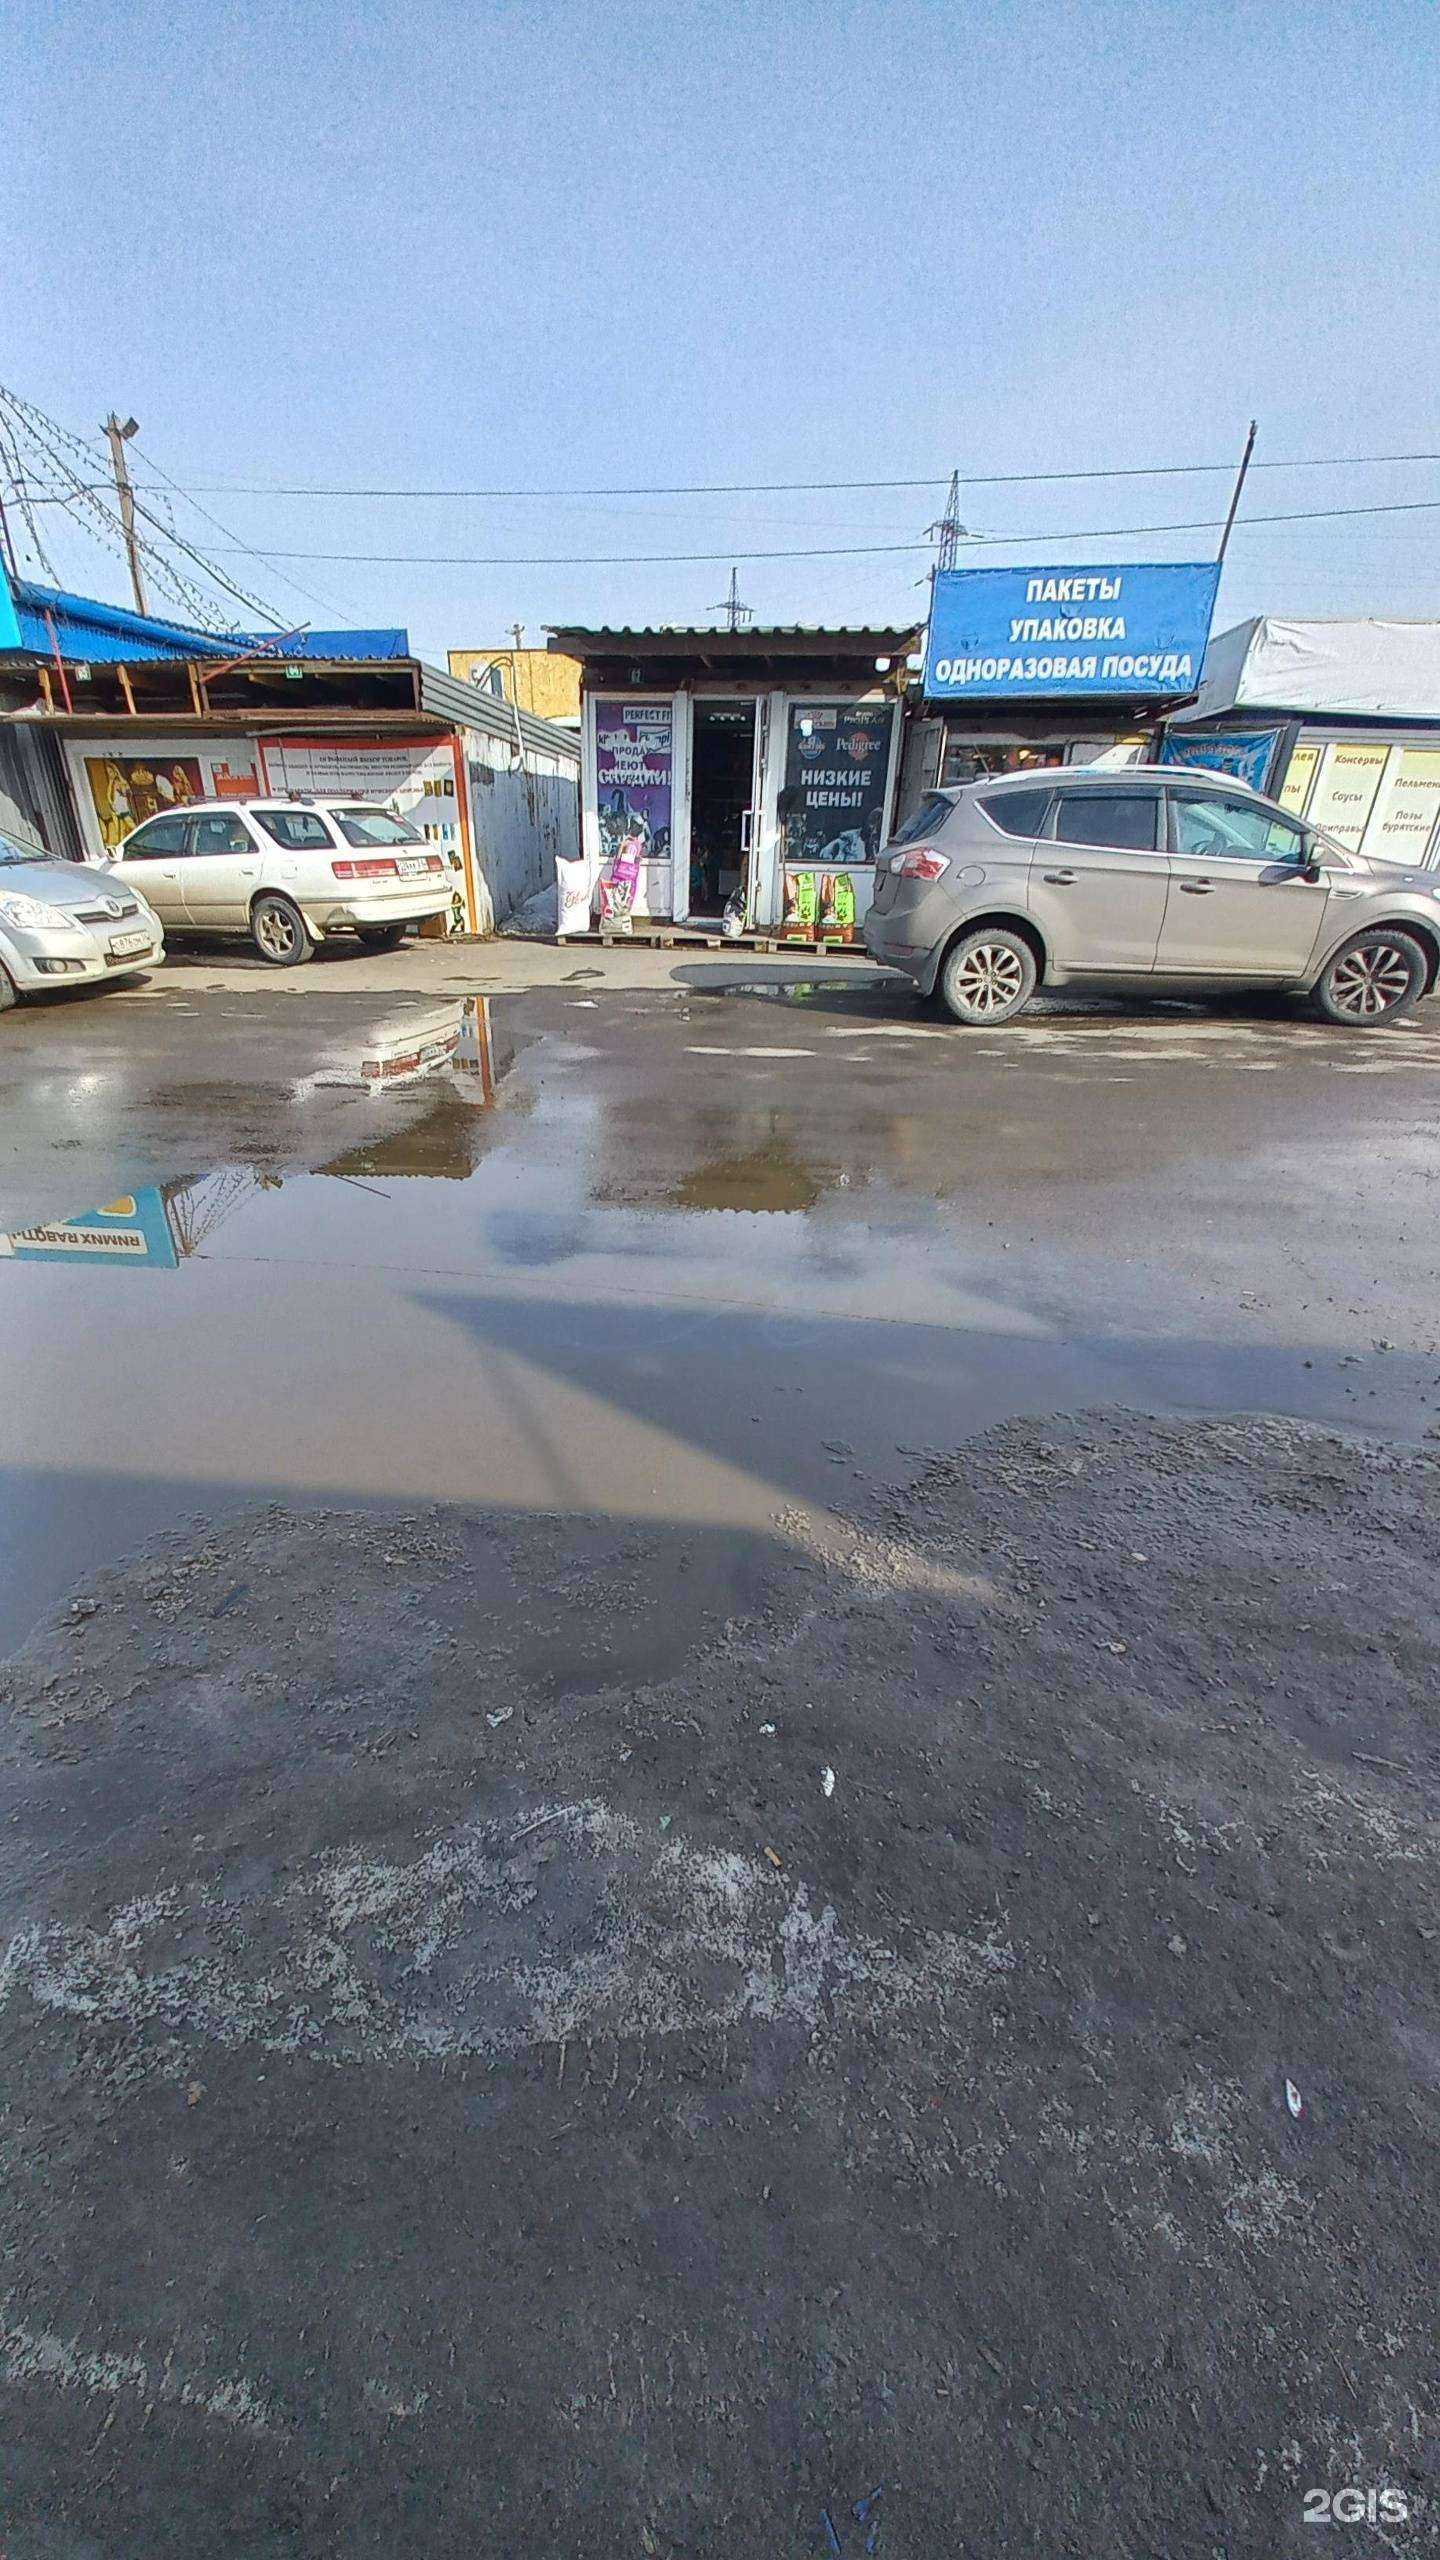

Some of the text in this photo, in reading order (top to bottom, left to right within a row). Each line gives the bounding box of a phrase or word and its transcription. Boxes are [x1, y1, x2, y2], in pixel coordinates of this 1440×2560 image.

[1026, 577, 1122, 602] ПАКЕТЫ
[1008, 617, 1126, 642] УПАКОВКА
[935, 654, 1192, 684] ОДНОРАЗОВАЯ ПОСУДА
[624, 709, 660, 720] PERFECT
[1334, 754, 1383, 766] Консервы
[801, 769, 872, 786] НИЗКИЕ
[806, 790, 864, 809] ЦЕНЫ!
[1332, 790, 1363, 803] Соусы
[1395, 810, 1423, 820] Позы
